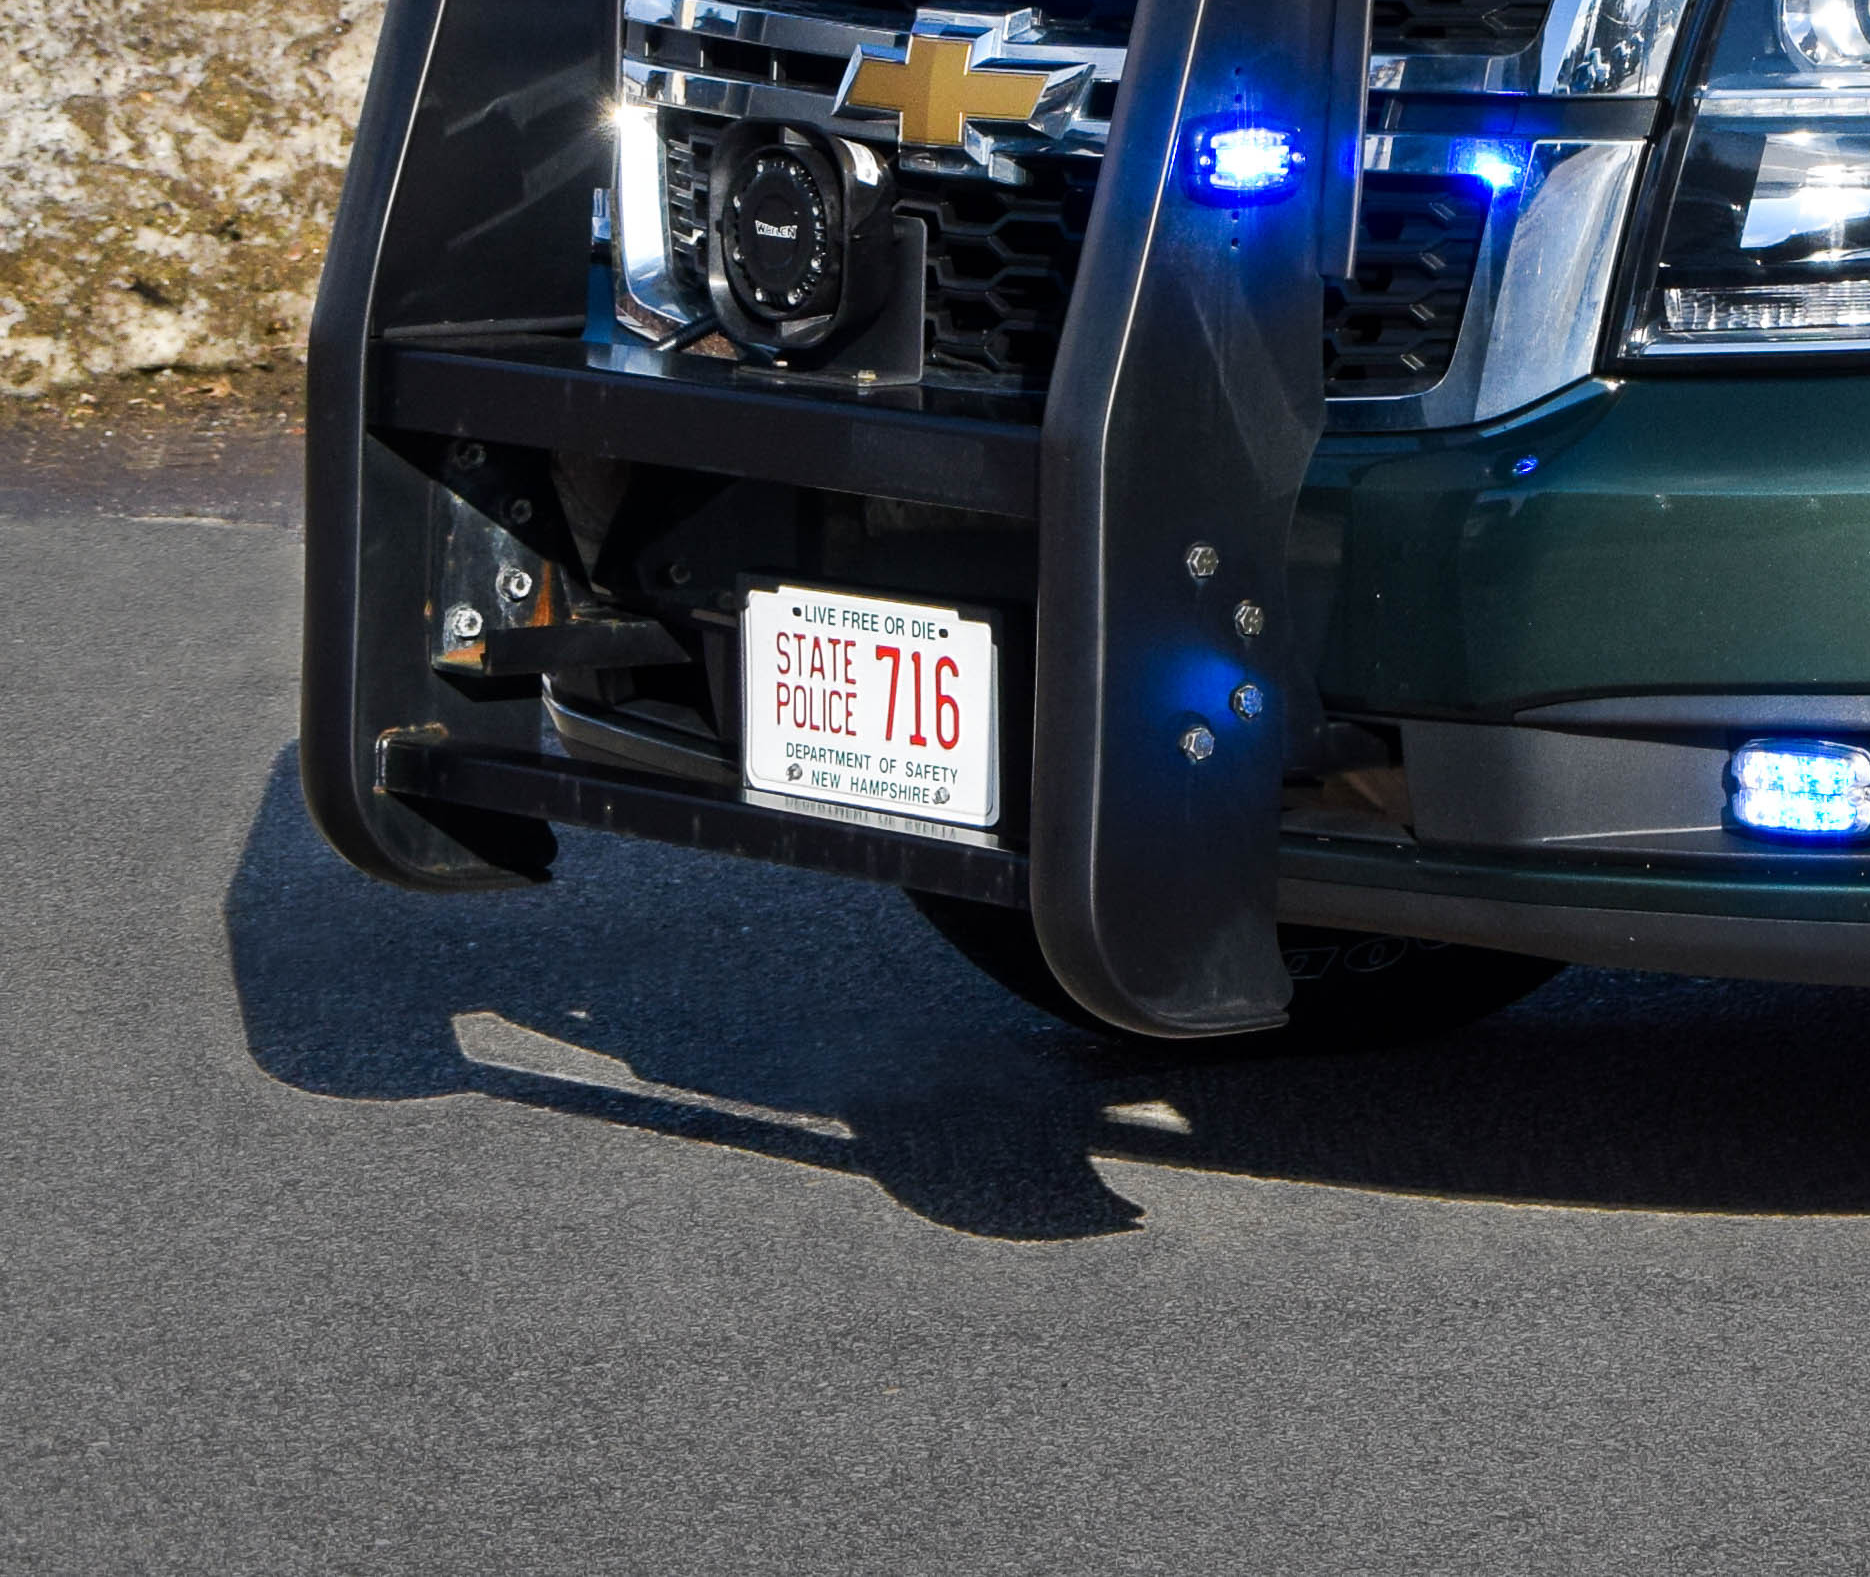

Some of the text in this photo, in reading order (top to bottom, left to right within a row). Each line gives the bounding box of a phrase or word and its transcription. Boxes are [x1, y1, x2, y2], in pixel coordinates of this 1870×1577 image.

[804, 605, 936, 641] LIVE FREE OR DIE
[776, 631, 857, 685] STATE
[776, 681, 857, 736] POLICE
[875, 644, 960, 751] 716
[786, 742, 958, 784] DEPARTMENT OF SAFETY
[811, 770, 929, 803] NEW HAMPSHIRE
